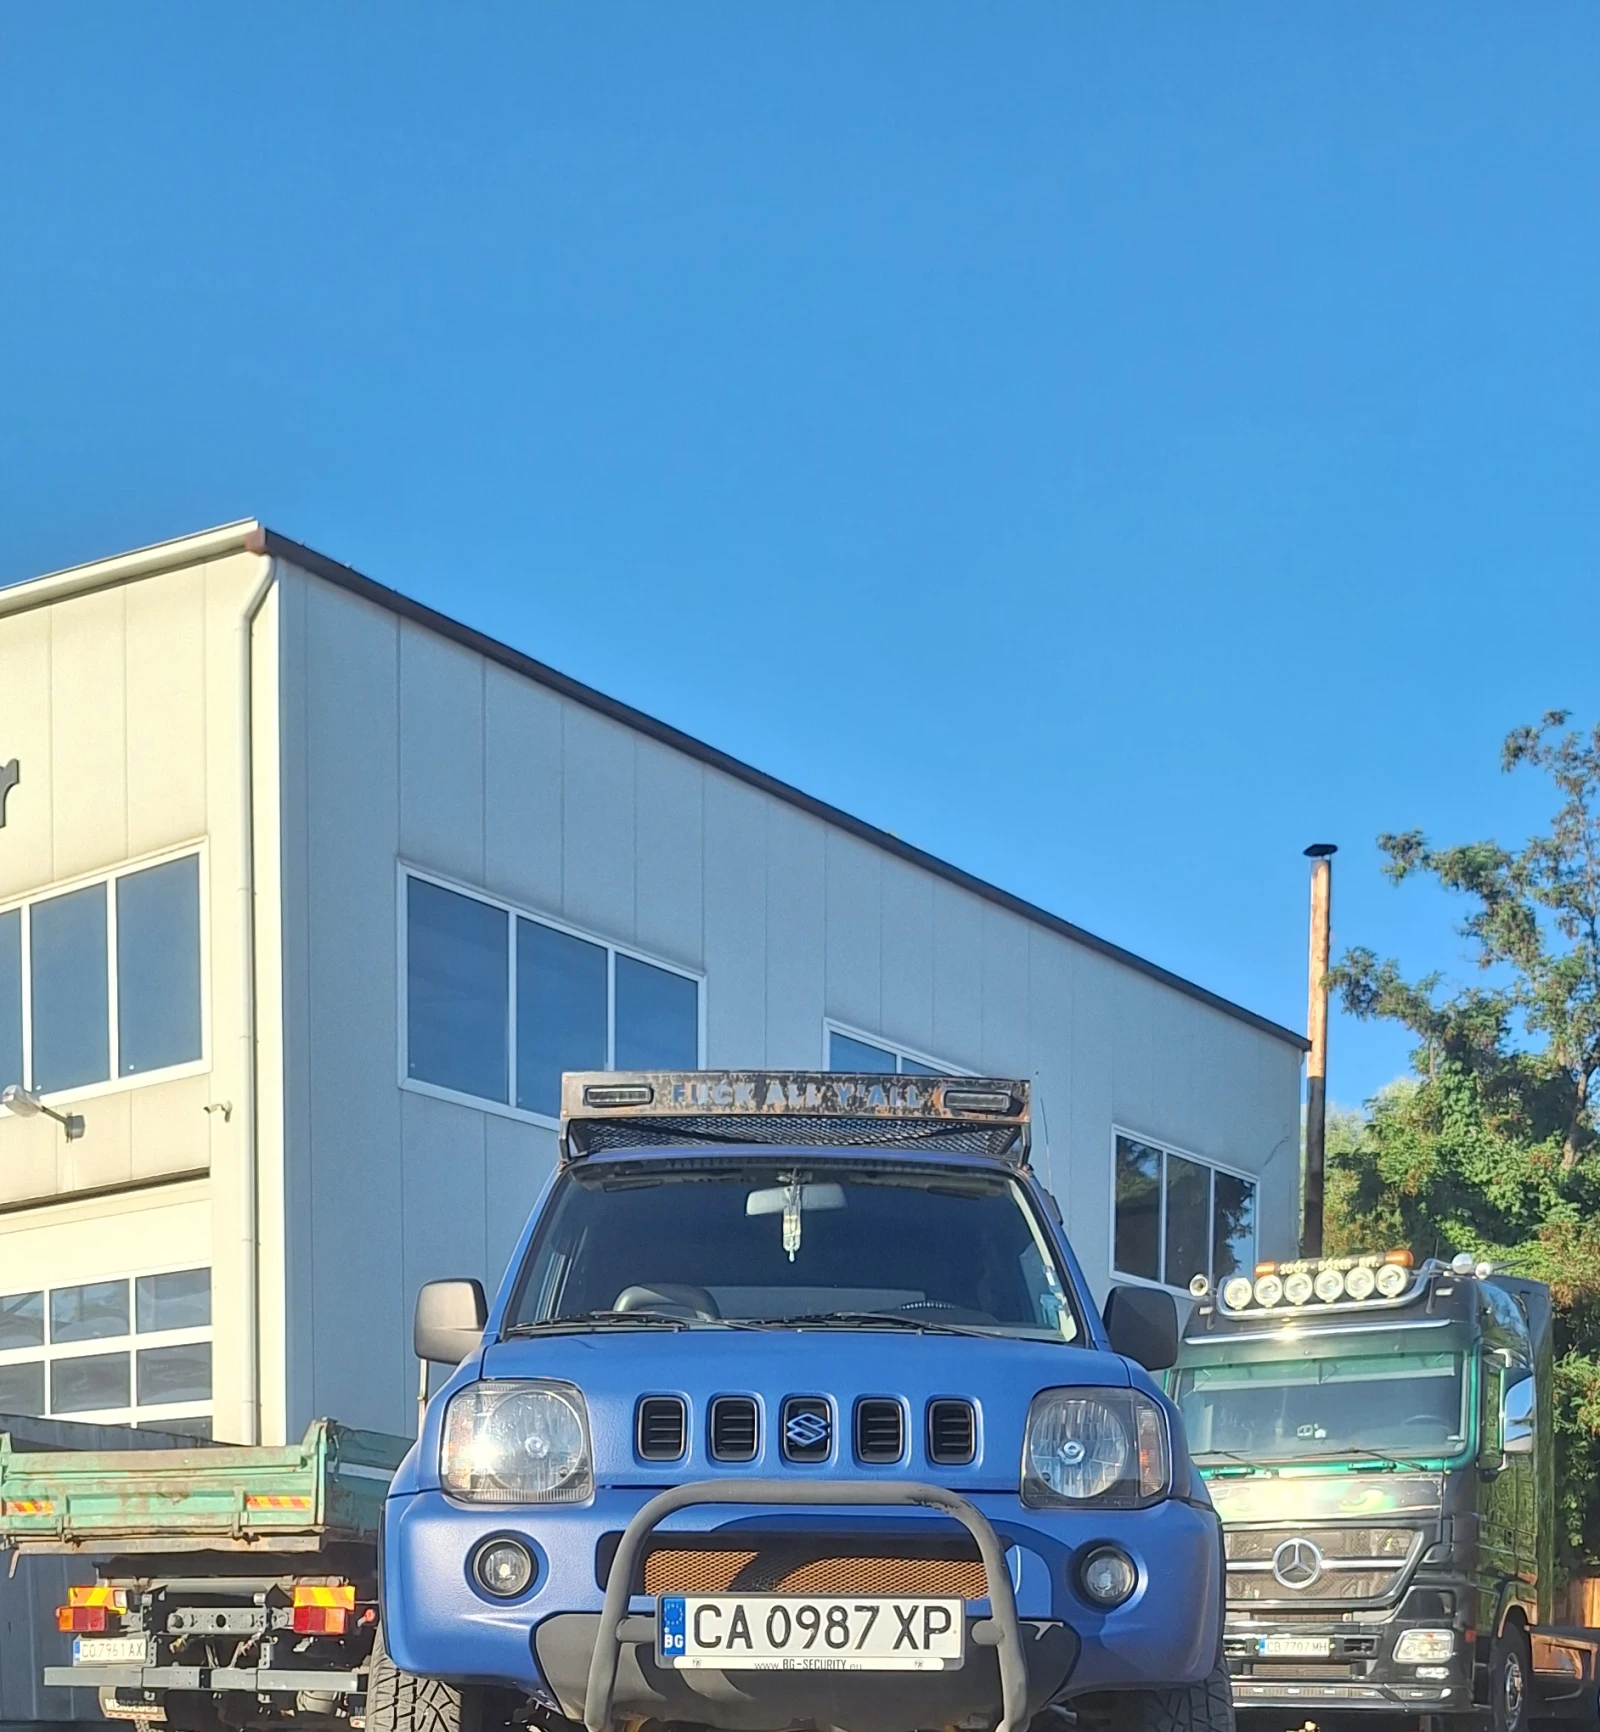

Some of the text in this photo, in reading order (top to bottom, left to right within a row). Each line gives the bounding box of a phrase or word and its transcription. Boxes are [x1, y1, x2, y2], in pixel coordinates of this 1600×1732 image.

[673, 1082, 757, 1106] FUCK
[693, 1604, 951, 1651] CA 0987 XP
[664, 1634, 684, 1649] BG
[1266, 1641, 1281, 1653] CB
[1283, 1641, 1310, 1653] 7707
[1312, 1641, 1327, 1652] MH
[99, 1643, 126, 1658] 7961
[127, 1642, 143, 1657] AX
